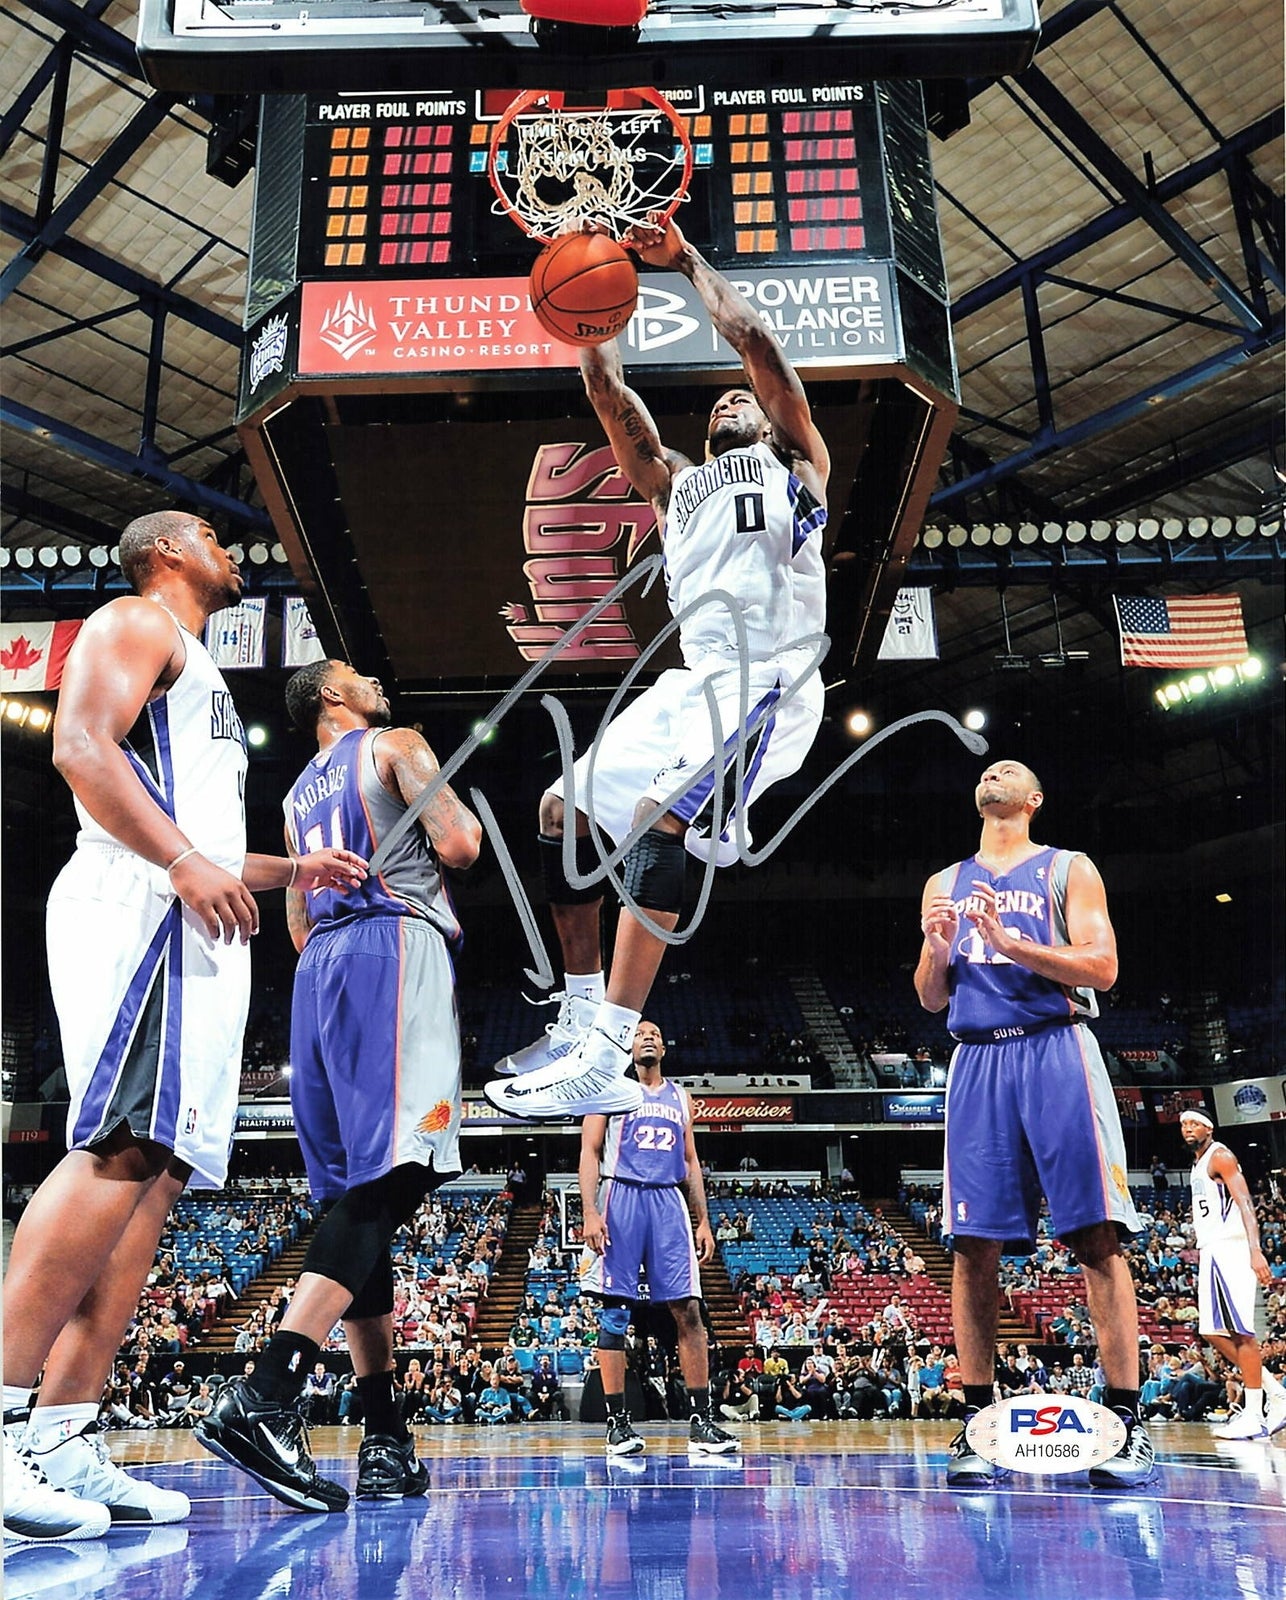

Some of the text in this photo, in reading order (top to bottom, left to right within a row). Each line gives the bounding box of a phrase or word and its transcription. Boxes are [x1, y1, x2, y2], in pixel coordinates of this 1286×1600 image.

[658, 89, 693, 102] ERIOD
[714, 86, 864, 105] PLAYER FOUL POINTS
[319, 100, 466, 120] PLAYER FOUL POINTS
[621, 119, 662, 135] LEFT
[729, 276, 880, 306] POWER
[389, 293, 533, 316] THUND
[574, 316, 629, 338] SPALD
[759, 306, 884, 331] ALANCE
[388, 319, 518, 343] VALLEY
[778, 329, 885, 347] VILION
[394, 343, 552, 358] CASINO RESORT
[676, 455, 765, 534] SACRAMENTO
[734, 493, 767, 534] 0
[222, 630, 238, 646] 14
[898, 625, 911, 635] 21
[294, 764, 348, 821] MORRIS
[955, 889, 1045, 921] PHENIX
[993, 1026, 1025, 1040] SUNS
[692, 1099, 792, 1119] Budweiser
[239, 1119, 295, 1127] HEALTH SYSTE
[20, 1131, 38, 1142] 119
[637, 1125, 673, 1152] 22
[1198, 1199, 1210, 1218] 5
